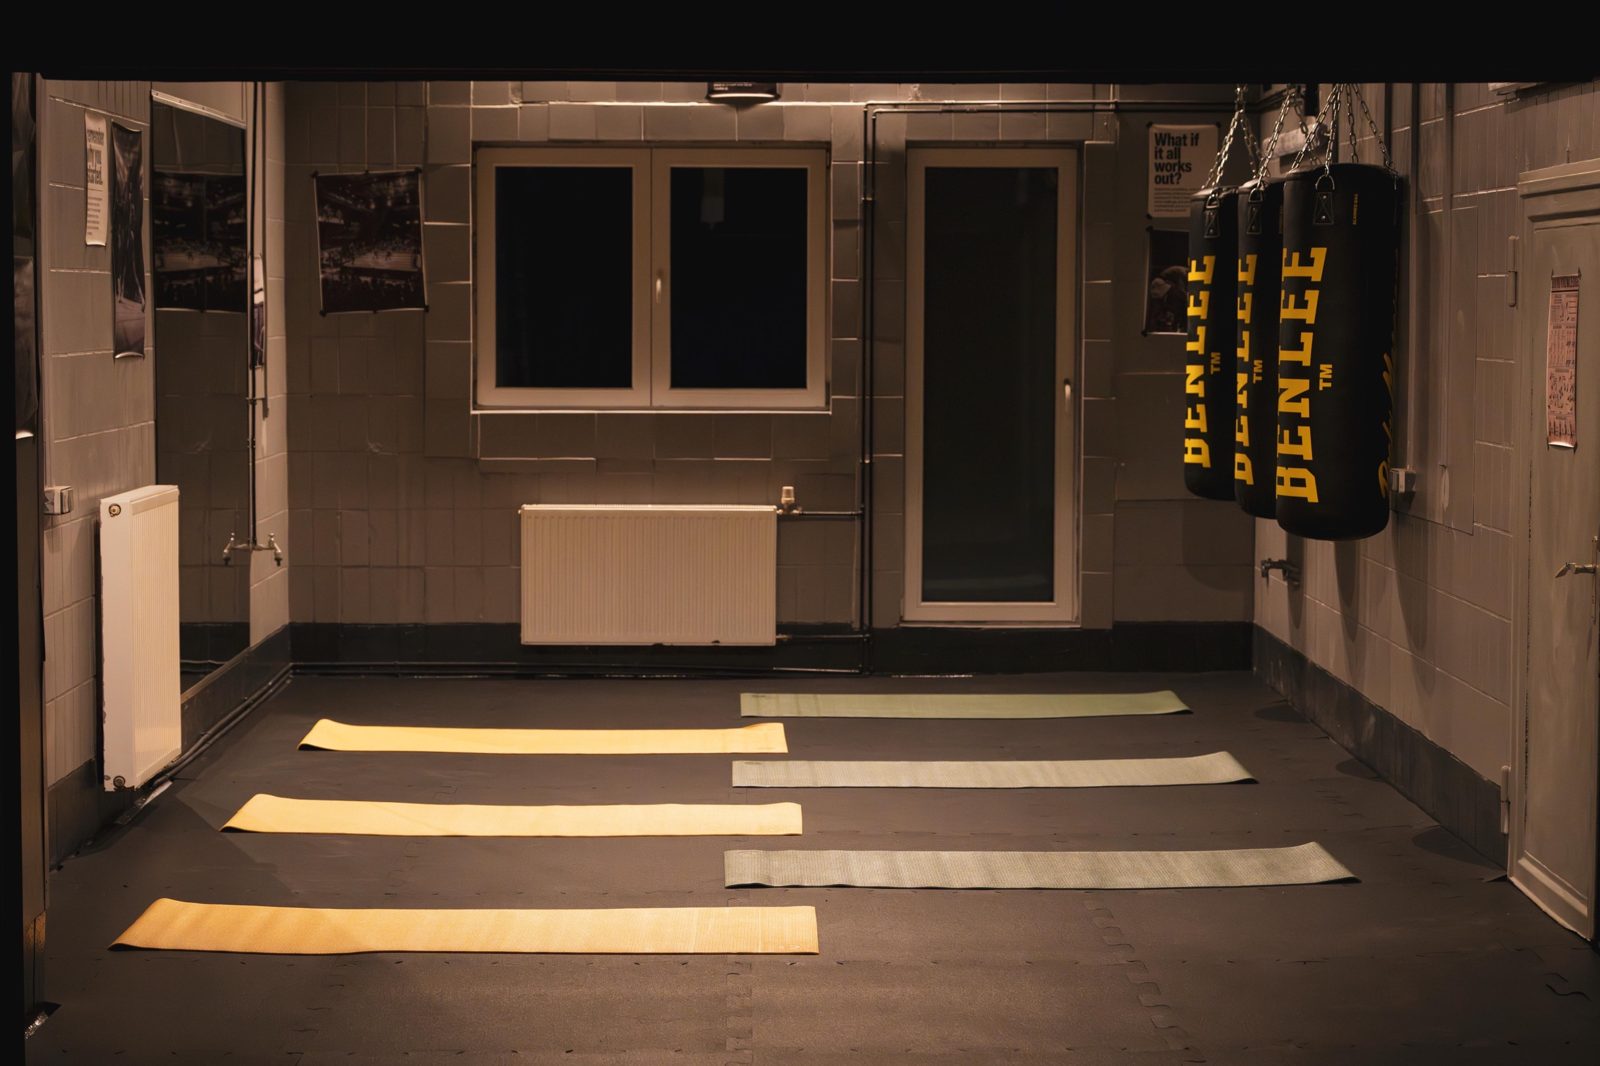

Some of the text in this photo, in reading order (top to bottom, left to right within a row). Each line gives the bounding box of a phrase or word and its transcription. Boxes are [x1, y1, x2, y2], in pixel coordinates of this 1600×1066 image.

[1154, 132, 1200, 147] What if
[1154, 146, 1181, 160] it all
[1154, 161, 1192, 173] works
[1154, 172, 1182, 185] out?
[1210, 352, 1222, 375] TM
[1252, 359, 1263, 384] TM
[1275, 247, 1328, 503] BENLEE
[1319, 363, 1333, 391] TM
